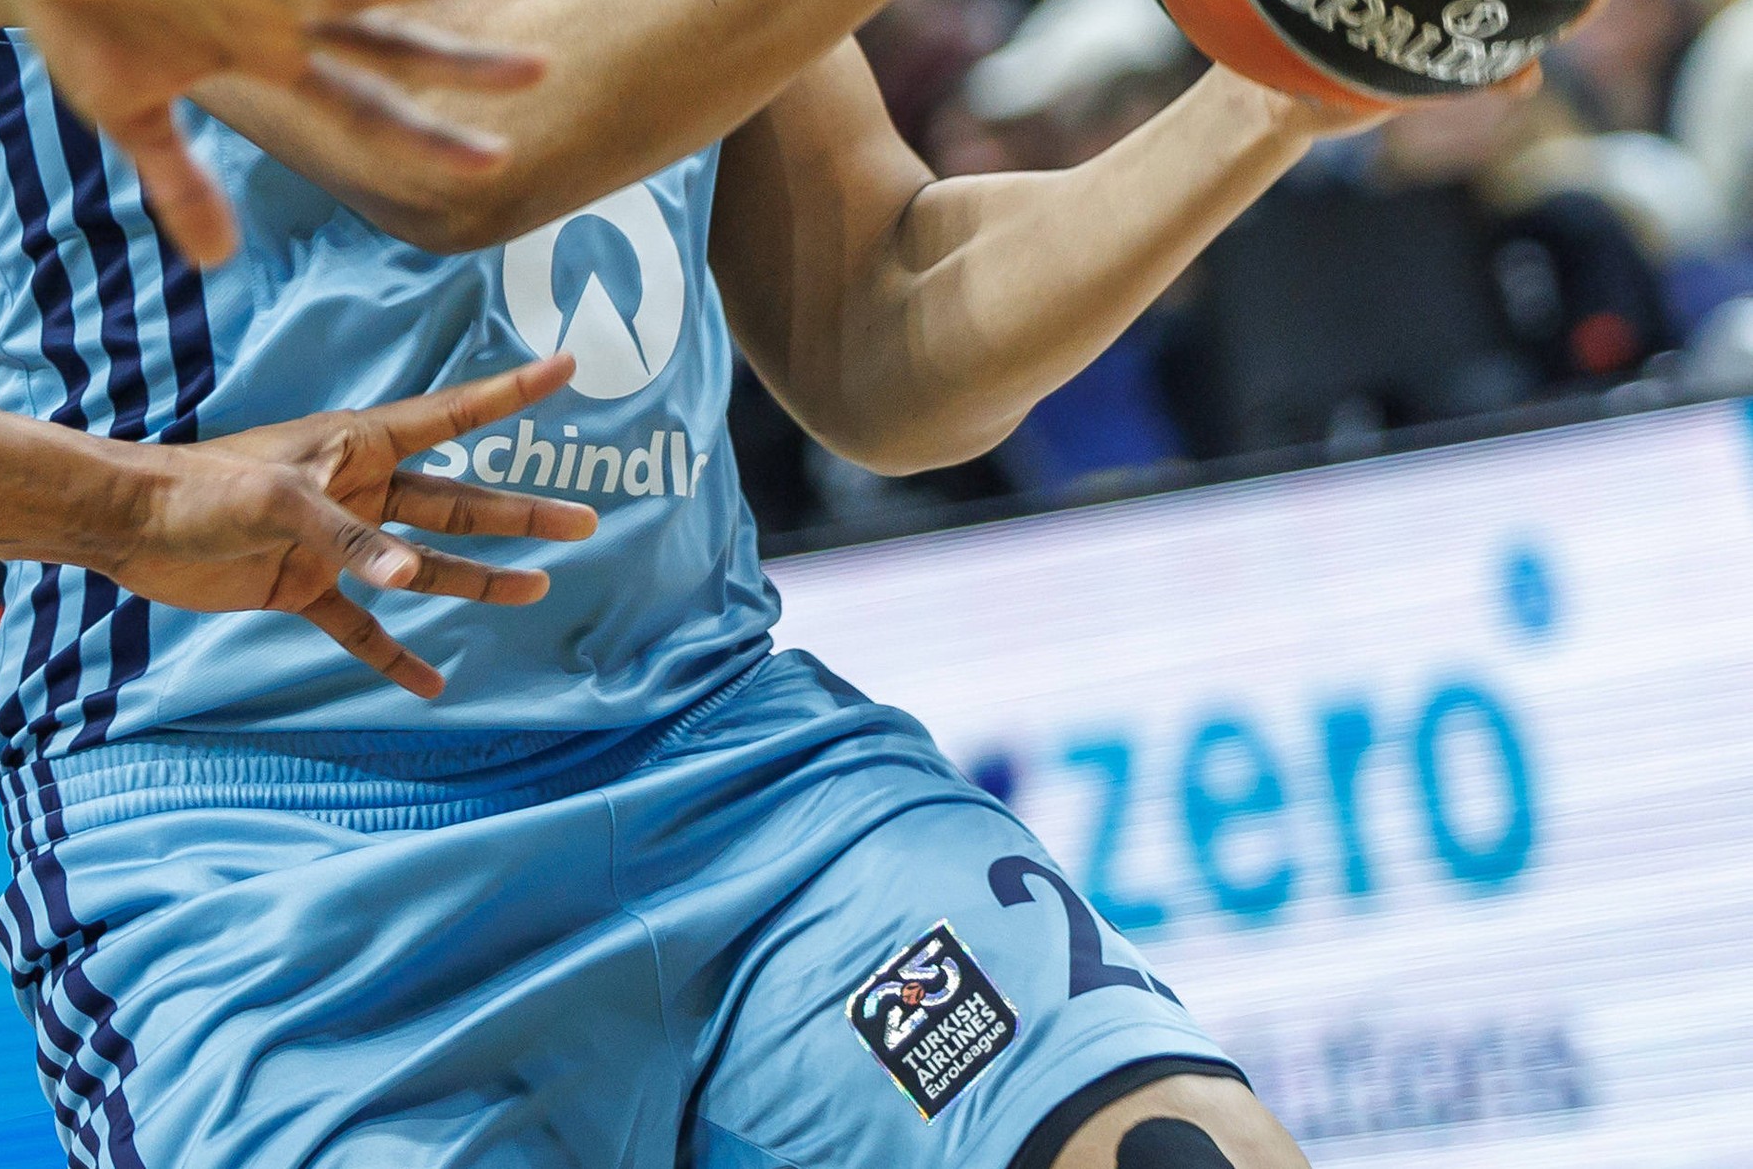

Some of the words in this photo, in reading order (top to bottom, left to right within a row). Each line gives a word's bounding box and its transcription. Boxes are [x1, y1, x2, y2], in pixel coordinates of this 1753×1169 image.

[902, 992, 986, 1069] TURKISH
[915, 1008, 997, 1088] AIRLINES
[924, 1020, 1007, 1100] EuroLeague
